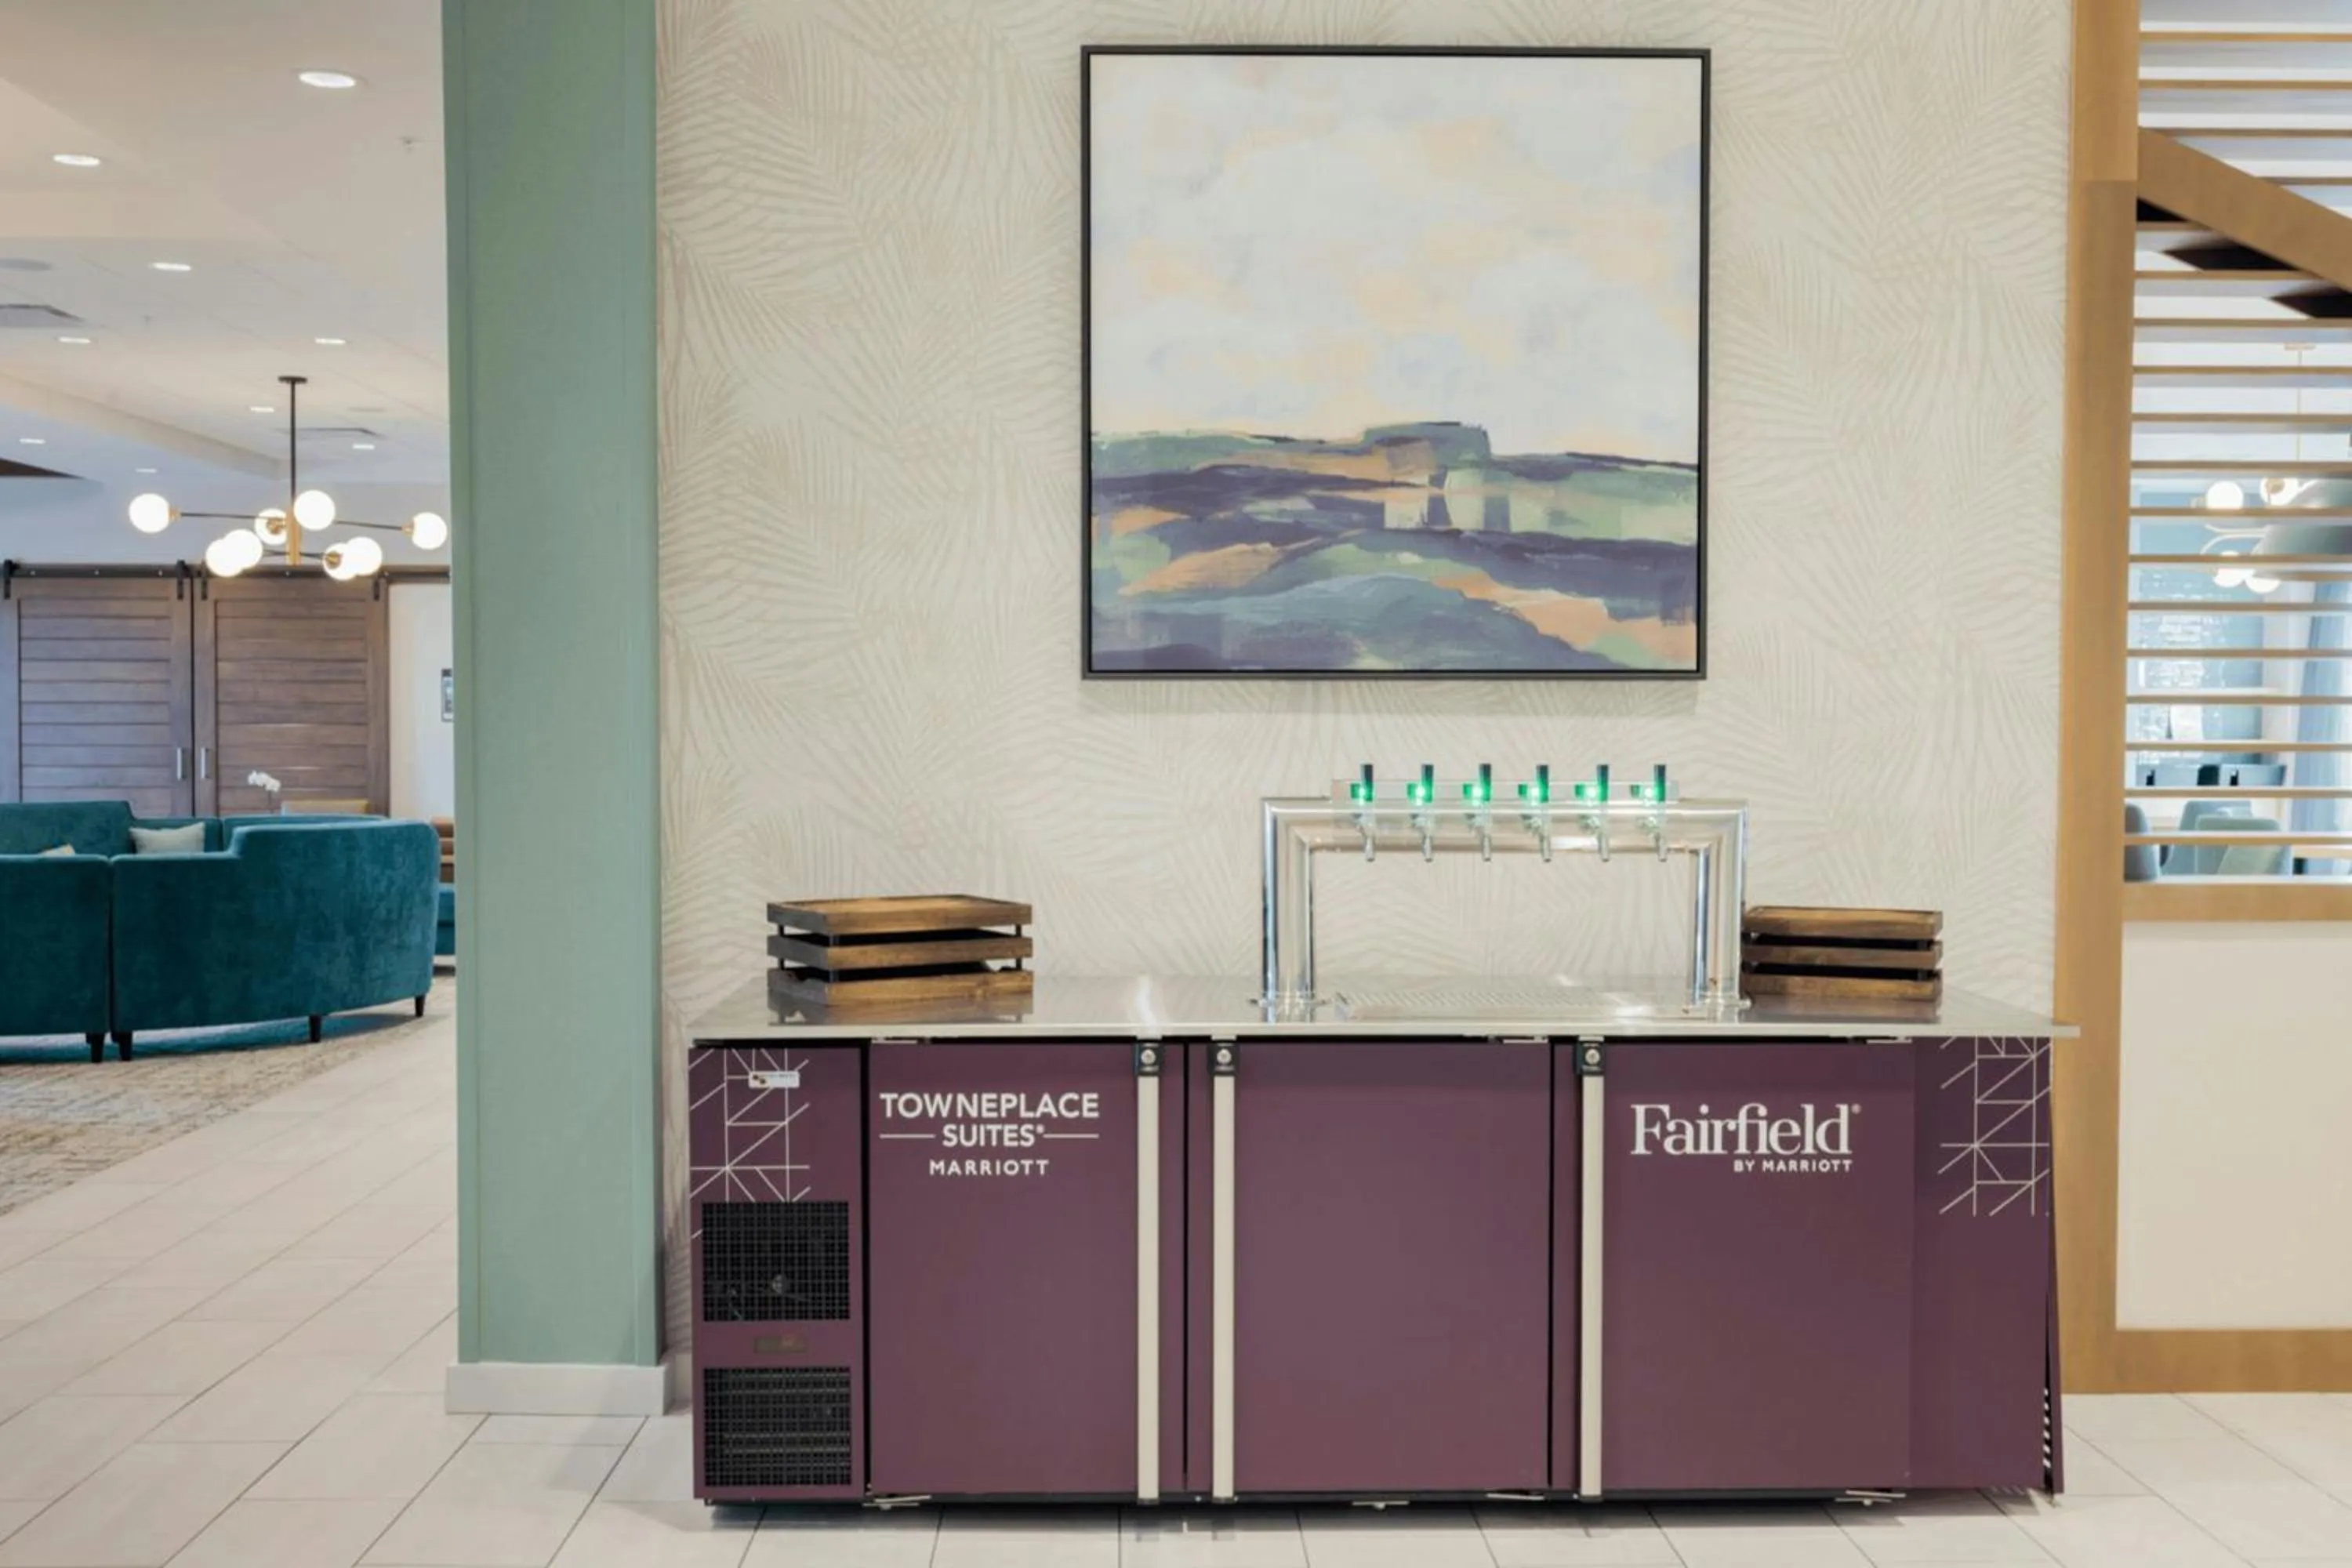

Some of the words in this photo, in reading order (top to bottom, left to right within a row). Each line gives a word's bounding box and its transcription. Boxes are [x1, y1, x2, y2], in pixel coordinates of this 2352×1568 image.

[880, 1092, 1099, 1118] TOWNEPLACE
[929, 1160, 1049, 1175] MARRIOTT
[1733, 1160, 1755, 1172] BY
[1762, 1160, 1853, 1172] MARRIOTT
